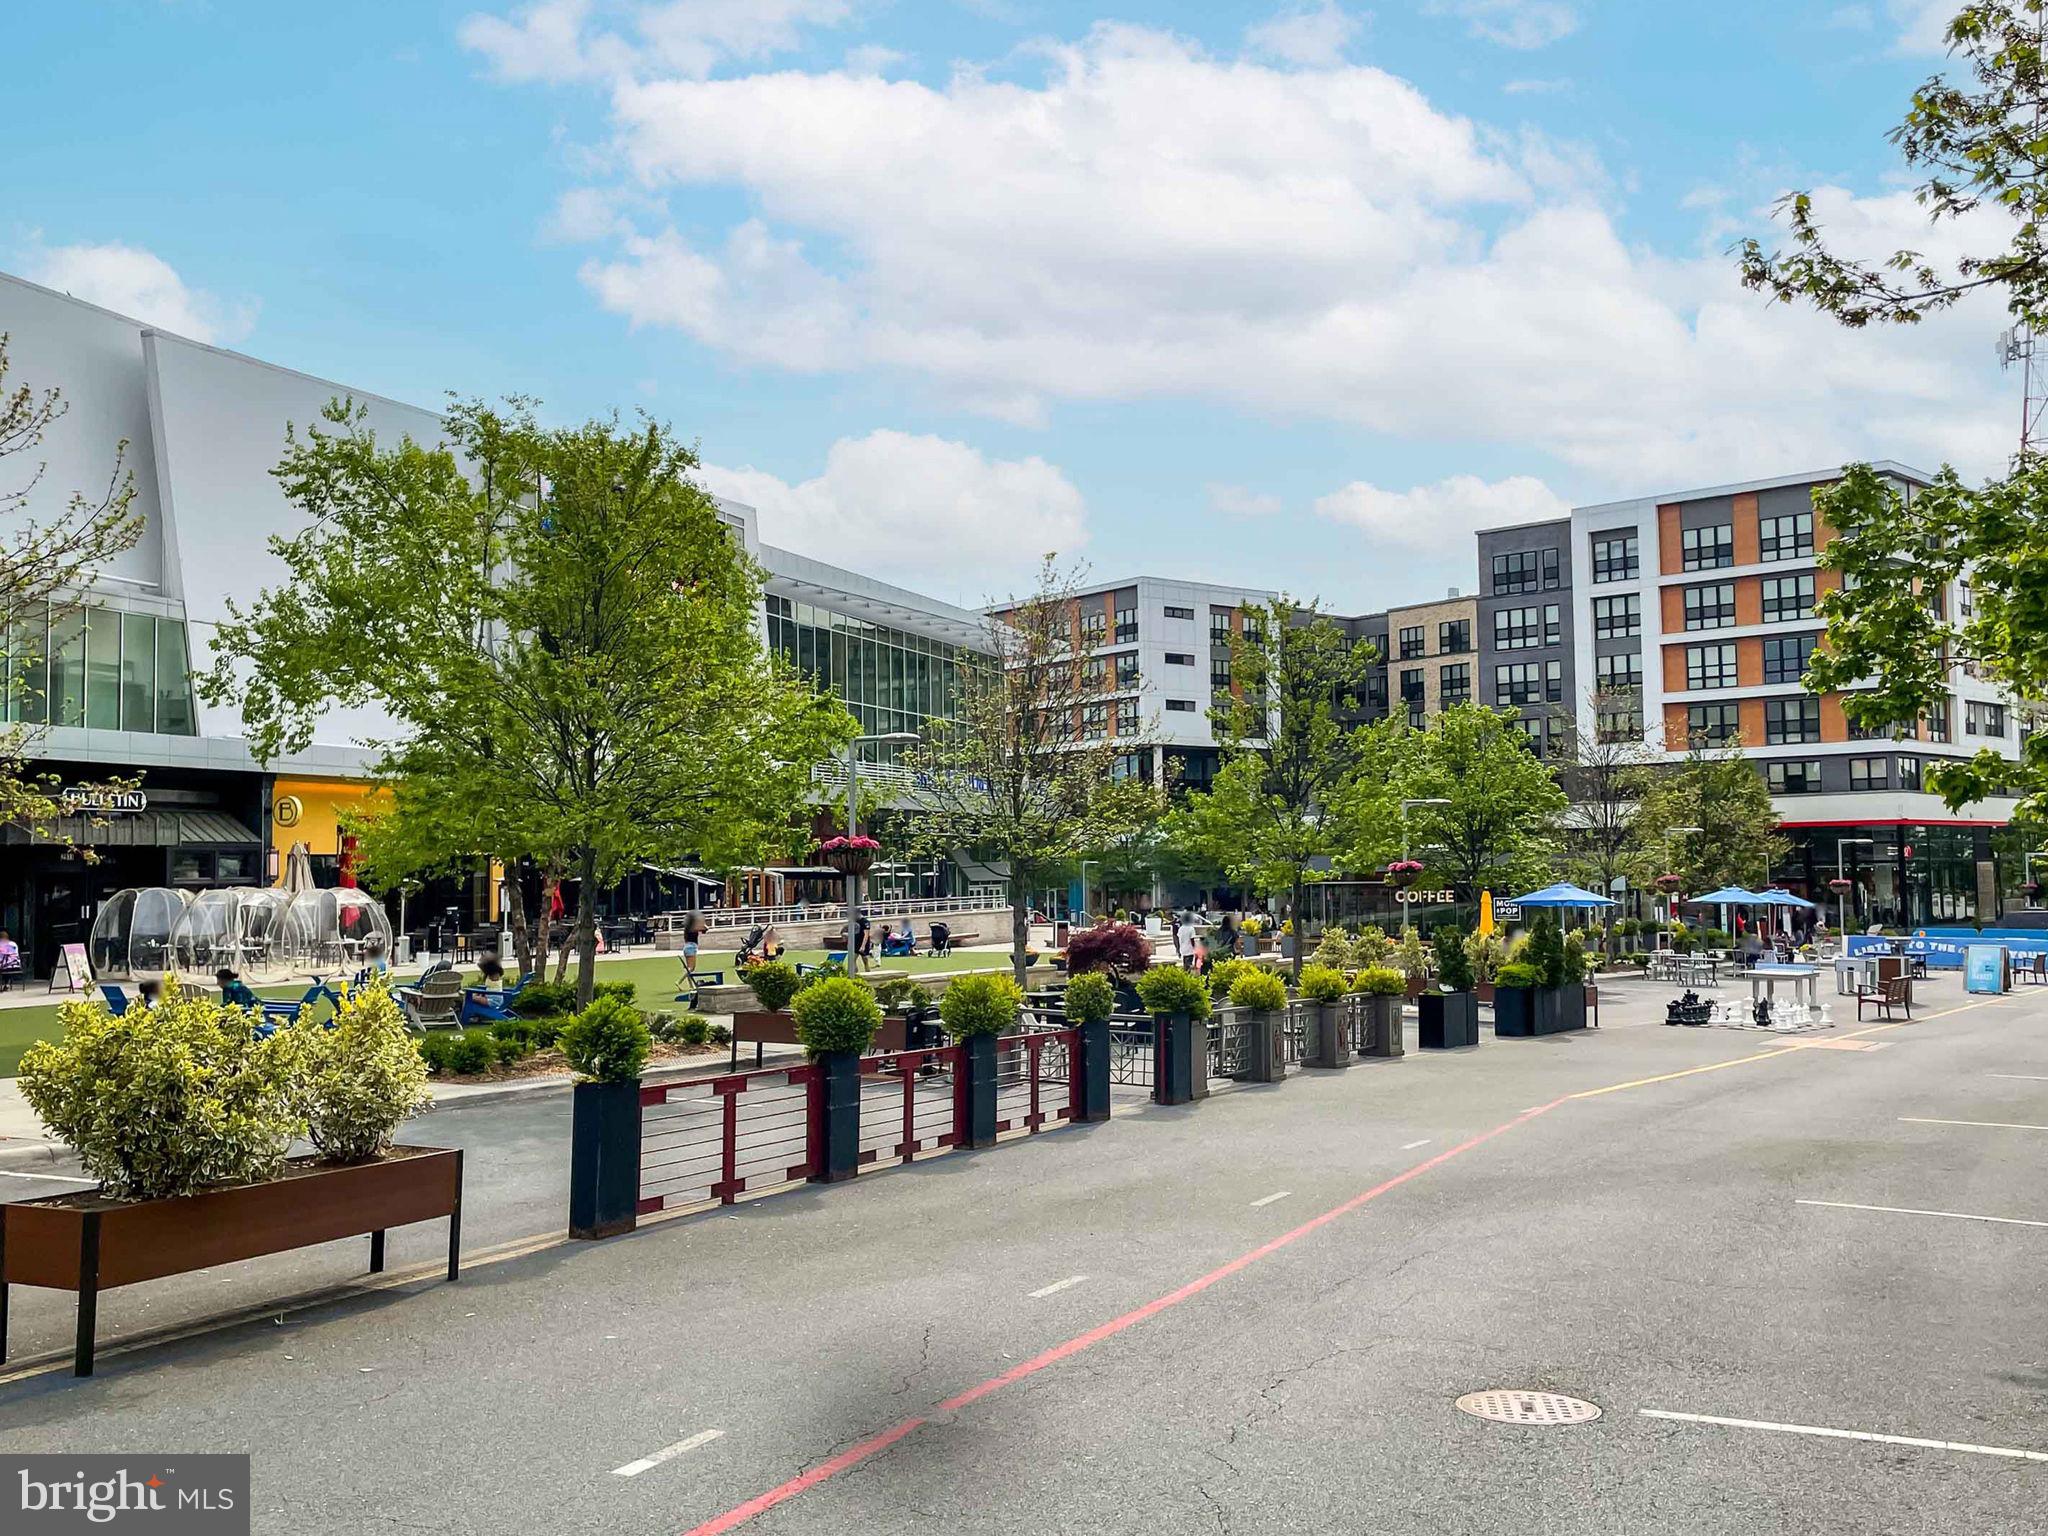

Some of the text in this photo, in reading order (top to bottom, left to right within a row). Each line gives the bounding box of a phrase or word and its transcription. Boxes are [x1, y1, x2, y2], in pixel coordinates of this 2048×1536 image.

[279, 803, 293, 821] B
[1395, 890, 1455, 903] COFFEE
[1854, 942, 1896, 957] LISTE
[1929, 941, 1956, 953] THE
[2008, 950, 2047, 960] YOU
